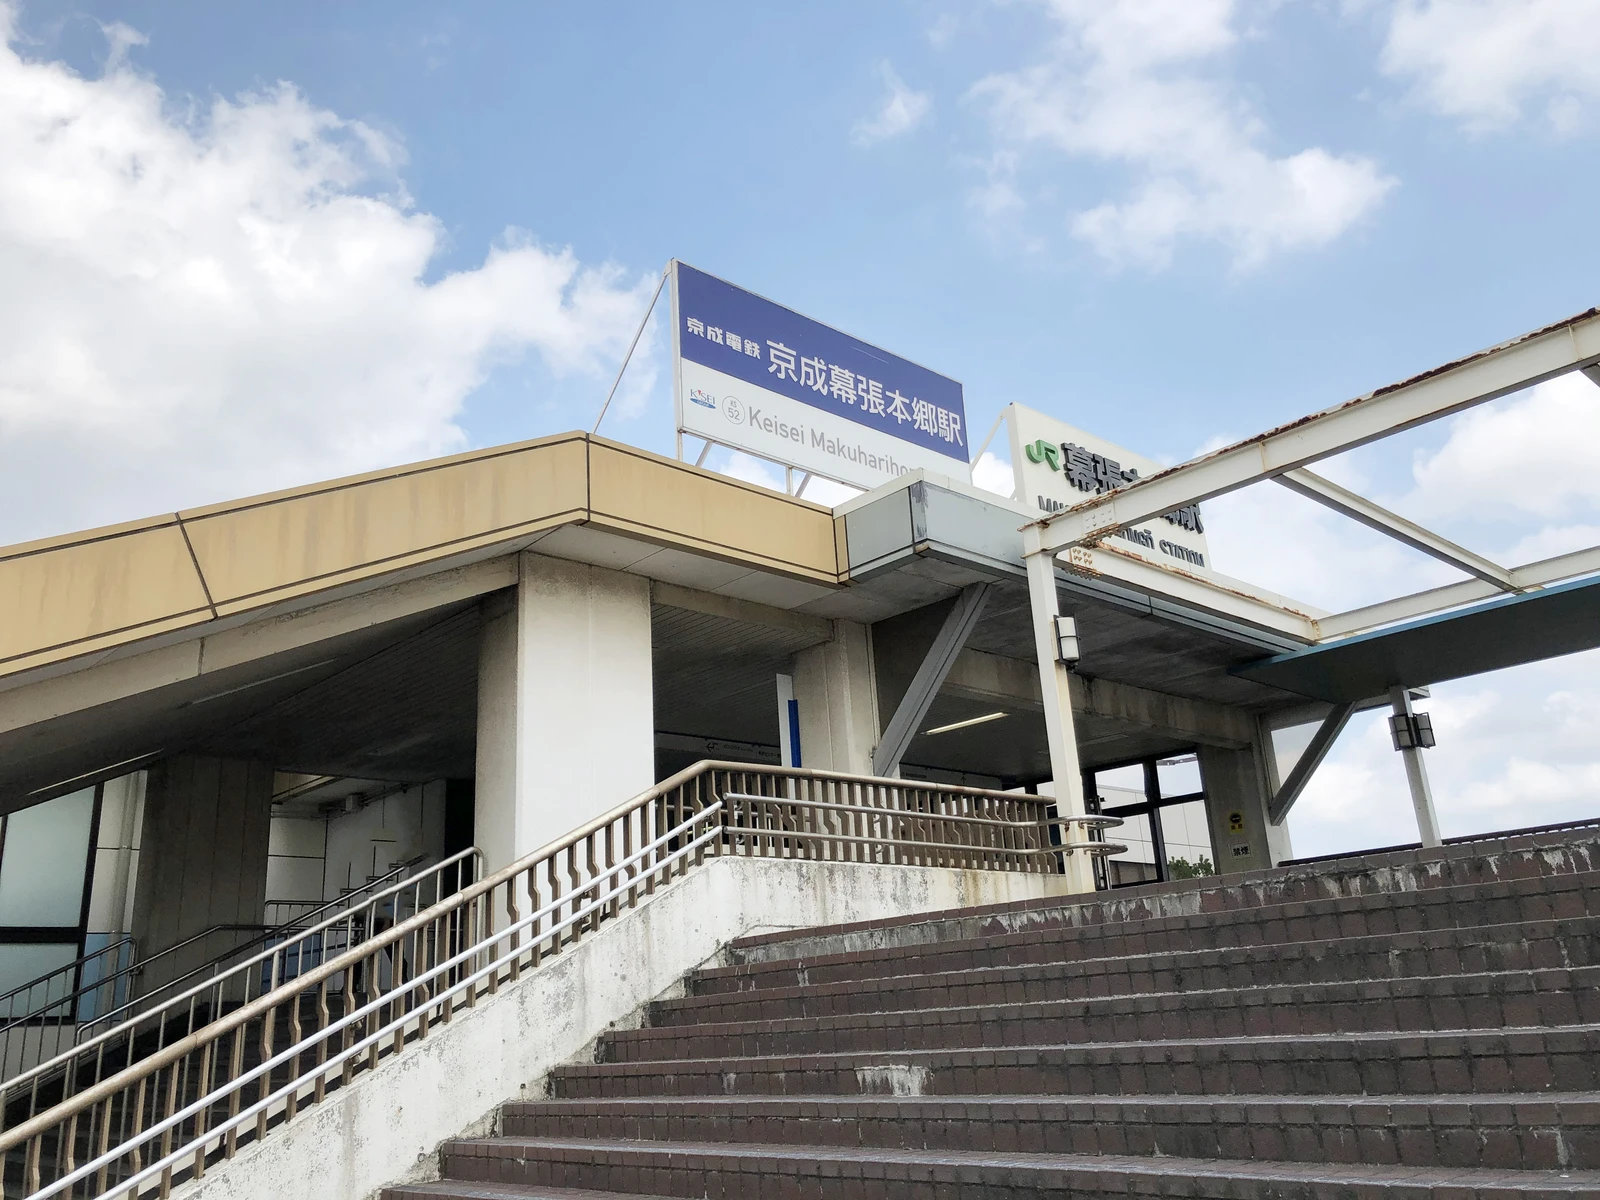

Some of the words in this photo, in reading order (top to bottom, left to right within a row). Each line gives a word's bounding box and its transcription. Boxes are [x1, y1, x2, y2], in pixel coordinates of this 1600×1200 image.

[686, 316, 761, 360] 京成電鉄
[766, 339, 964, 447] 京成幕張本郷駅
[728, 408, 741, 421] 52
[748, 405, 805, 445] Keisei
[810, 427, 915, 477] Makuhariho
[1025, 439, 1060, 472] JR
[1158, 538, 1205, 568] STATION
